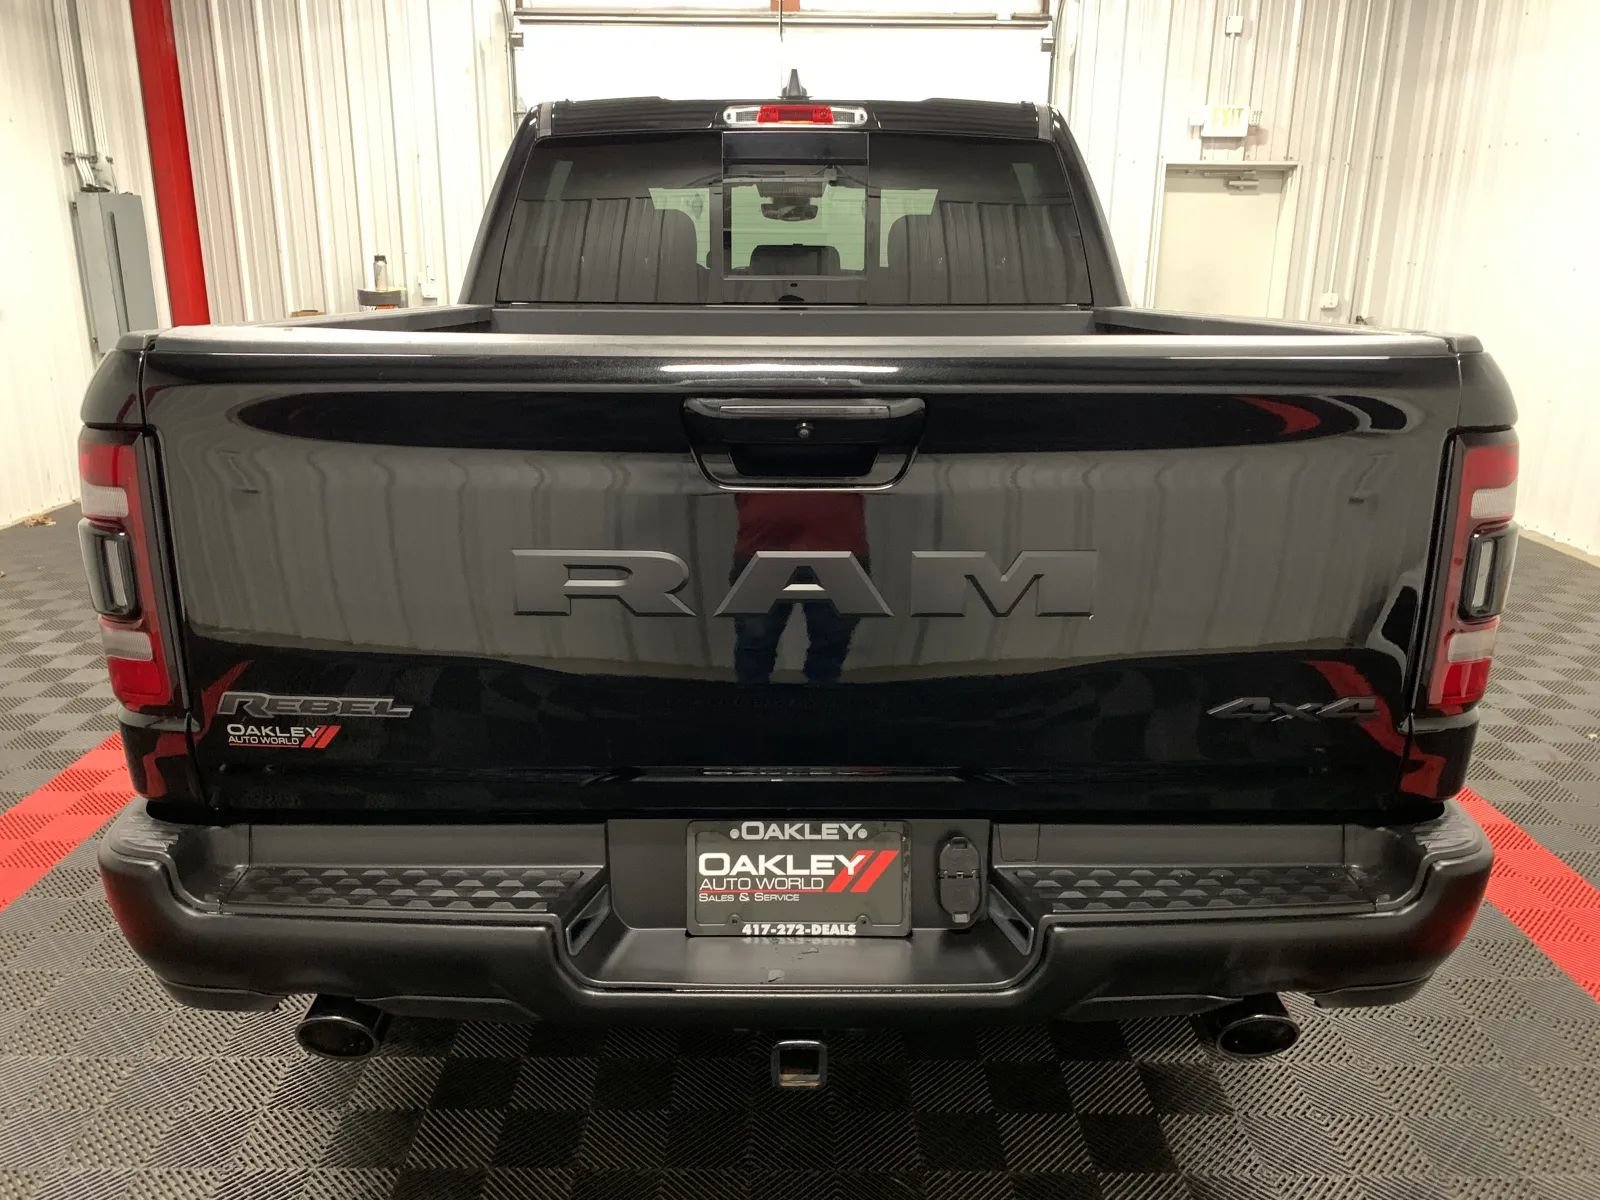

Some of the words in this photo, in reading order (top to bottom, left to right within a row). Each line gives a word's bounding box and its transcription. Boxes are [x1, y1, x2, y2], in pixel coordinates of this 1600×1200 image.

[511, 549, 1098, 617] RAM
[216, 691, 413, 718] REBEL
[226, 723, 320, 737] OAKLEY
[228, 735, 259, 744] AUTO
[260, 737, 300, 745] WORLD
[741, 821, 862, 840] OAKLEY
[698, 852, 867, 876] OAKLEY
[699, 877, 751, 890] AUTO
[755, 877, 824, 890] WORLD
[738, 892, 750, 902] &
[741, 924, 857, 936] 417-272-DEALS
